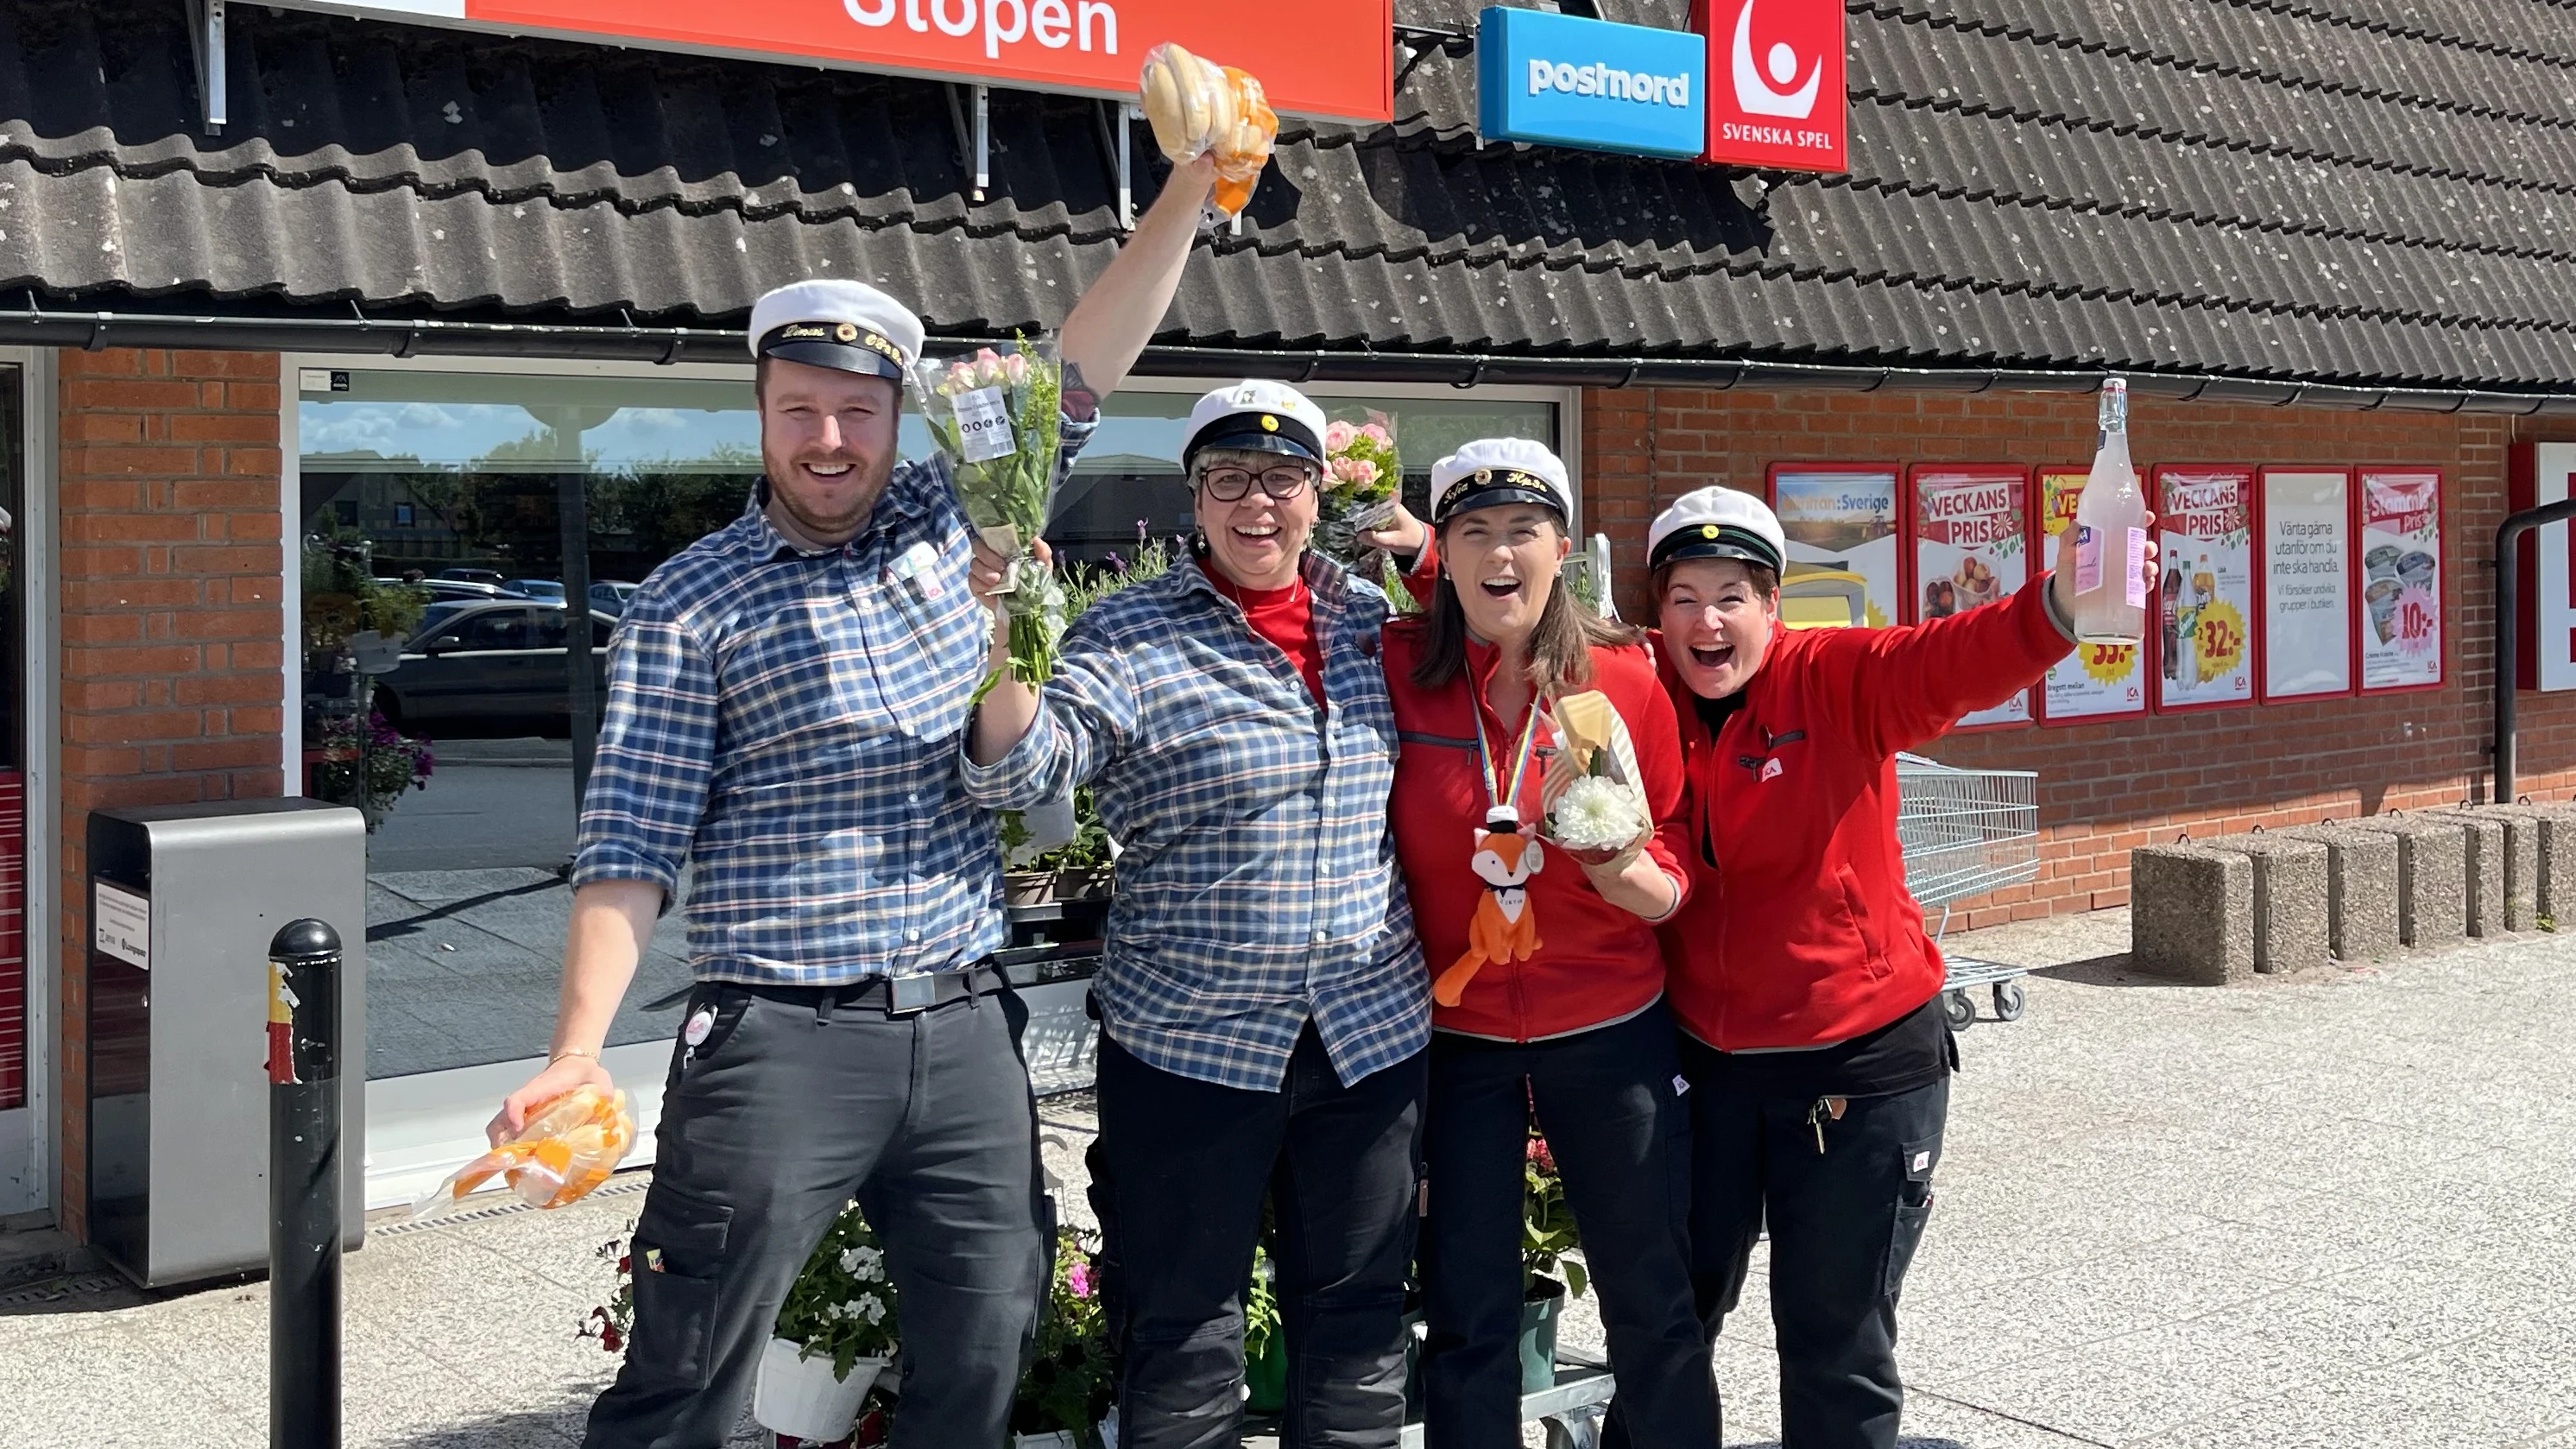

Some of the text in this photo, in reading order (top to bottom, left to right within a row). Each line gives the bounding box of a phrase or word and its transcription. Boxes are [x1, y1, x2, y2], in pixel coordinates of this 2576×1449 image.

[1528, 58, 1689, 108] postnord
[1722, 123, 1833, 150] SVENSKA SPEL
[1931, 487, 2007, 518] VECKANS
[2172, 485, 2238, 511] VECKANS
[1950, 520, 1990, 545] PRIS
[2188, 514, 2223, 536] PRIS
[2279, 521, 2333, 539] Vänta gärna
[2275, 540, 2337, 555] utanför om du
[2273, 560, 2292, 575] inte
[2292, 559, 2308, 574] ska
[2402, 602, 2434, 639] 10:-
[2198, 627, 2204, 641] 2
[2008, 696, 2023, 708] ICA
[2126, 687, 2139, 698] ICA
